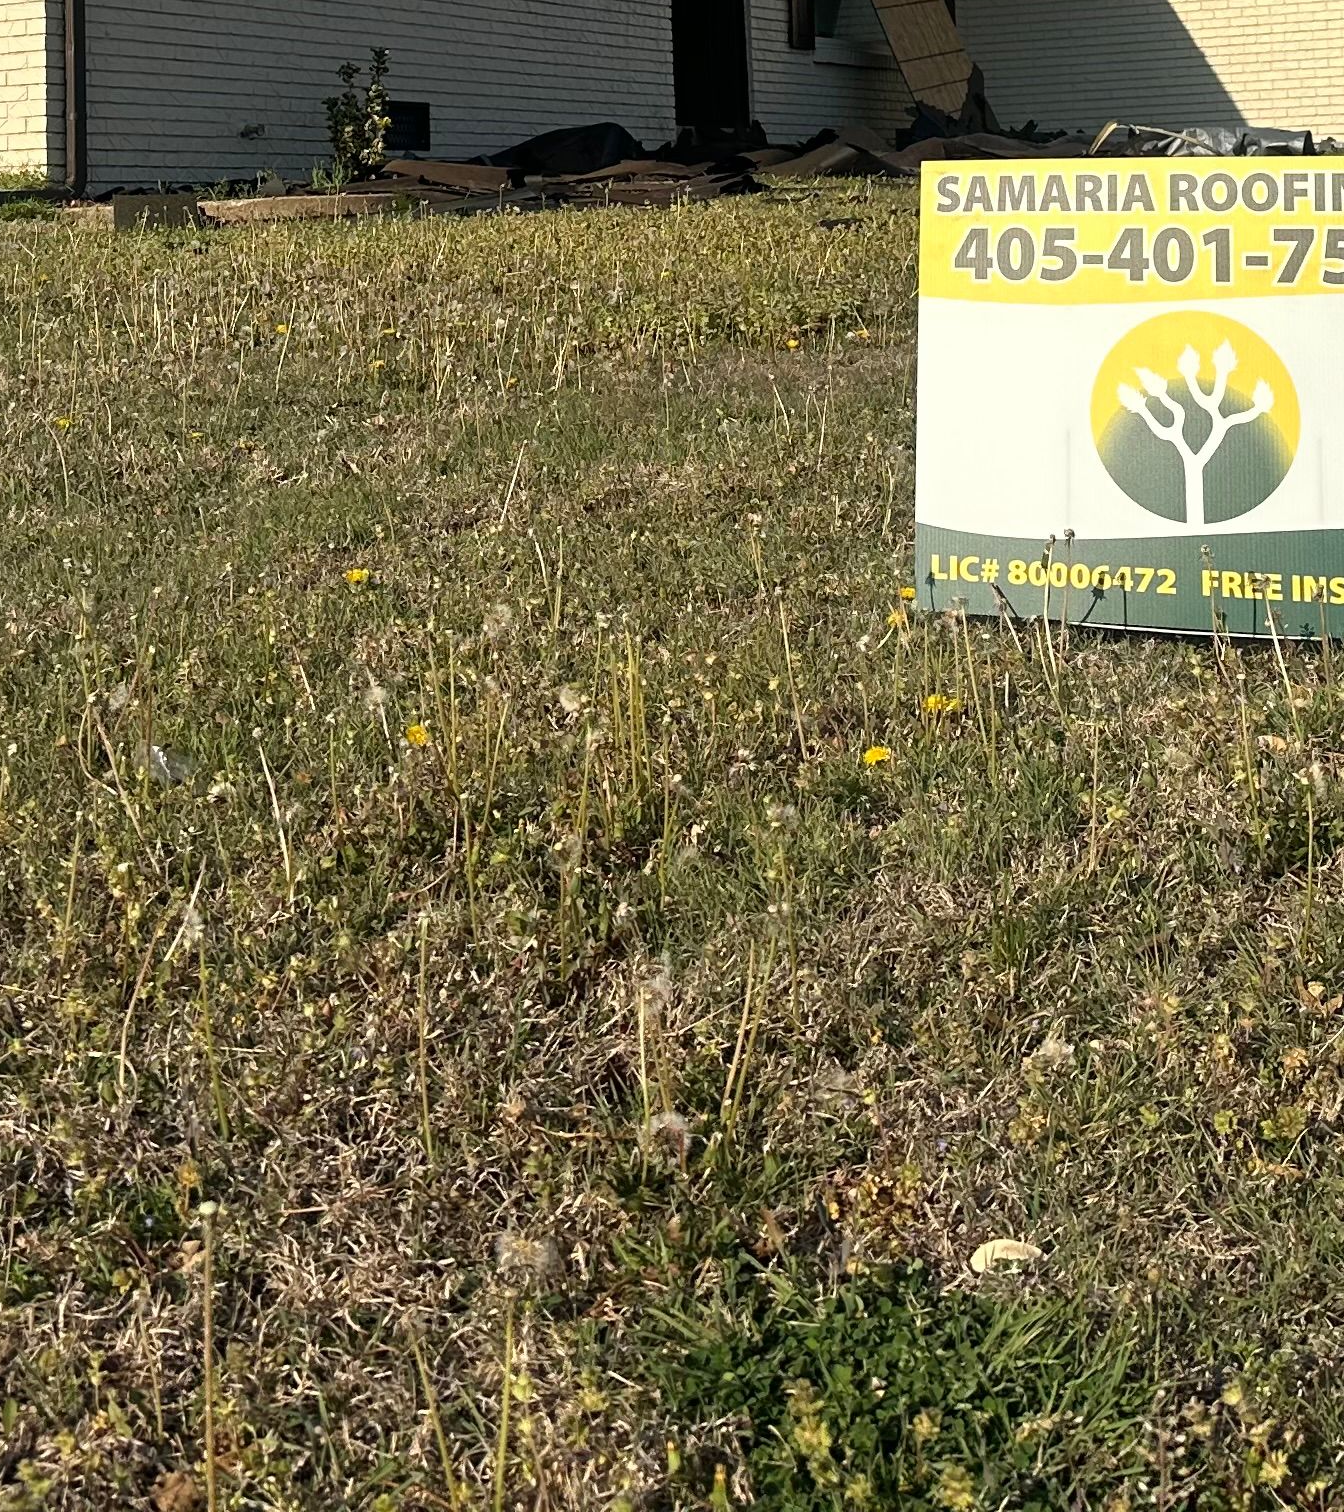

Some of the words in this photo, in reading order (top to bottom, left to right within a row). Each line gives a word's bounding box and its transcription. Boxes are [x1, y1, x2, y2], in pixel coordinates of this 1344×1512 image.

[936, 173, 1156, 213] SAMARIA
[930, 553, 1000, 584] LIC#
[1007, 559, 1177, 595] 80006472
[1201, 569, 1284, 601] FREE
